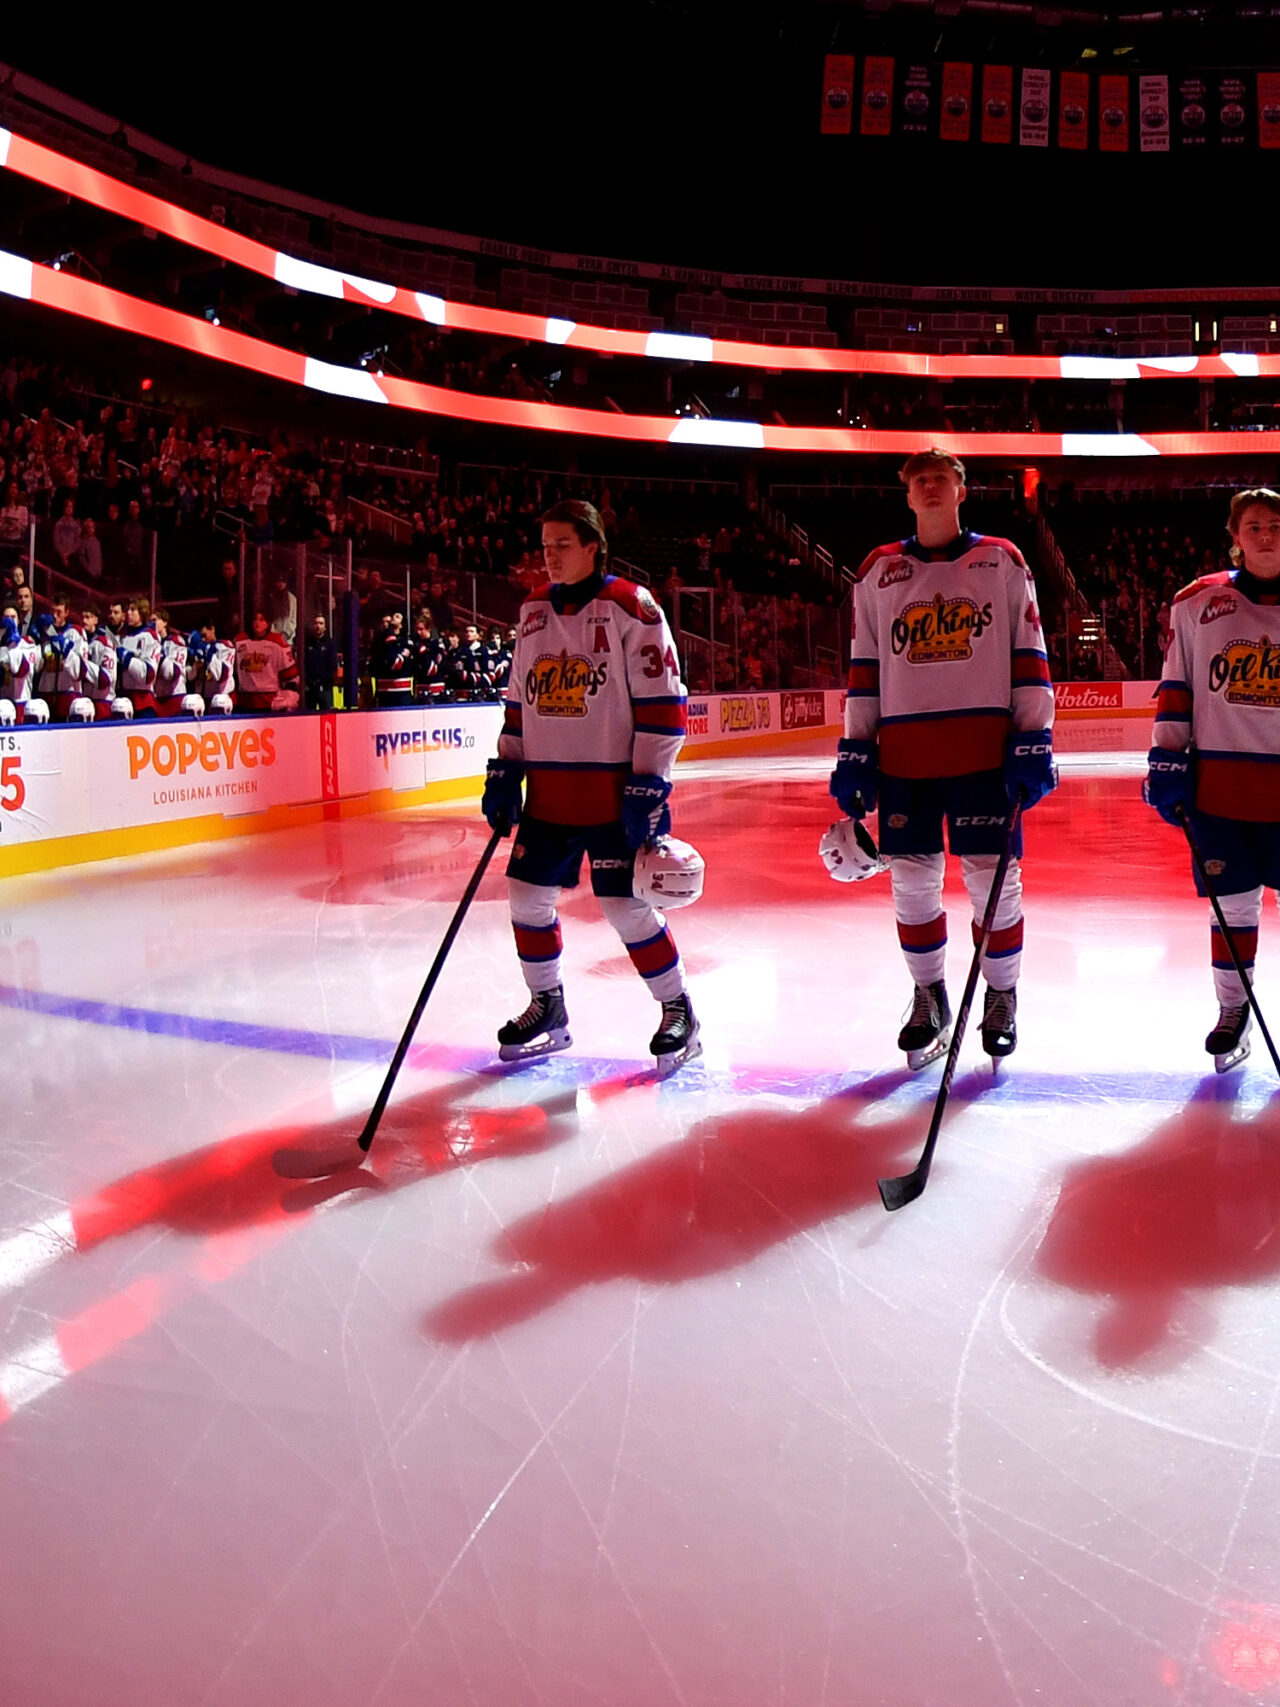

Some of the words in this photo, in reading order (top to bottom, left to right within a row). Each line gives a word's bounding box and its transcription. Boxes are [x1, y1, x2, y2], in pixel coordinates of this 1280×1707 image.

[593, 626, 611, 653] A
[892, 613, 935, 655] Oil
[936, 602, 992, 637] Kings
[102, 655, 114, 670] 20
[640, 644, 680, 679] 34
[911, 649, 969, 661] EDMONTON
[526, 666, 558, 705] Oil
[559, 660, 607, 695] Kings
[1209, 654, 1257, 692] Oil
[1055, 685, 1118, 707] Hortons
[687, 703, 709, 717] ADIAN
[720, 697, 756, 733] PIZZA
[686, 717, 709, 735] TORE
[324, 720, 335, 795] CCM
[0, 756, 26, 811] 5
[153, 786, 213, 805] LOUISIANA
[215, 780, 258, 797] KITCHEN
[955, 815, 1006, 827] CCM
[591, 858, 632, 870] CCM
